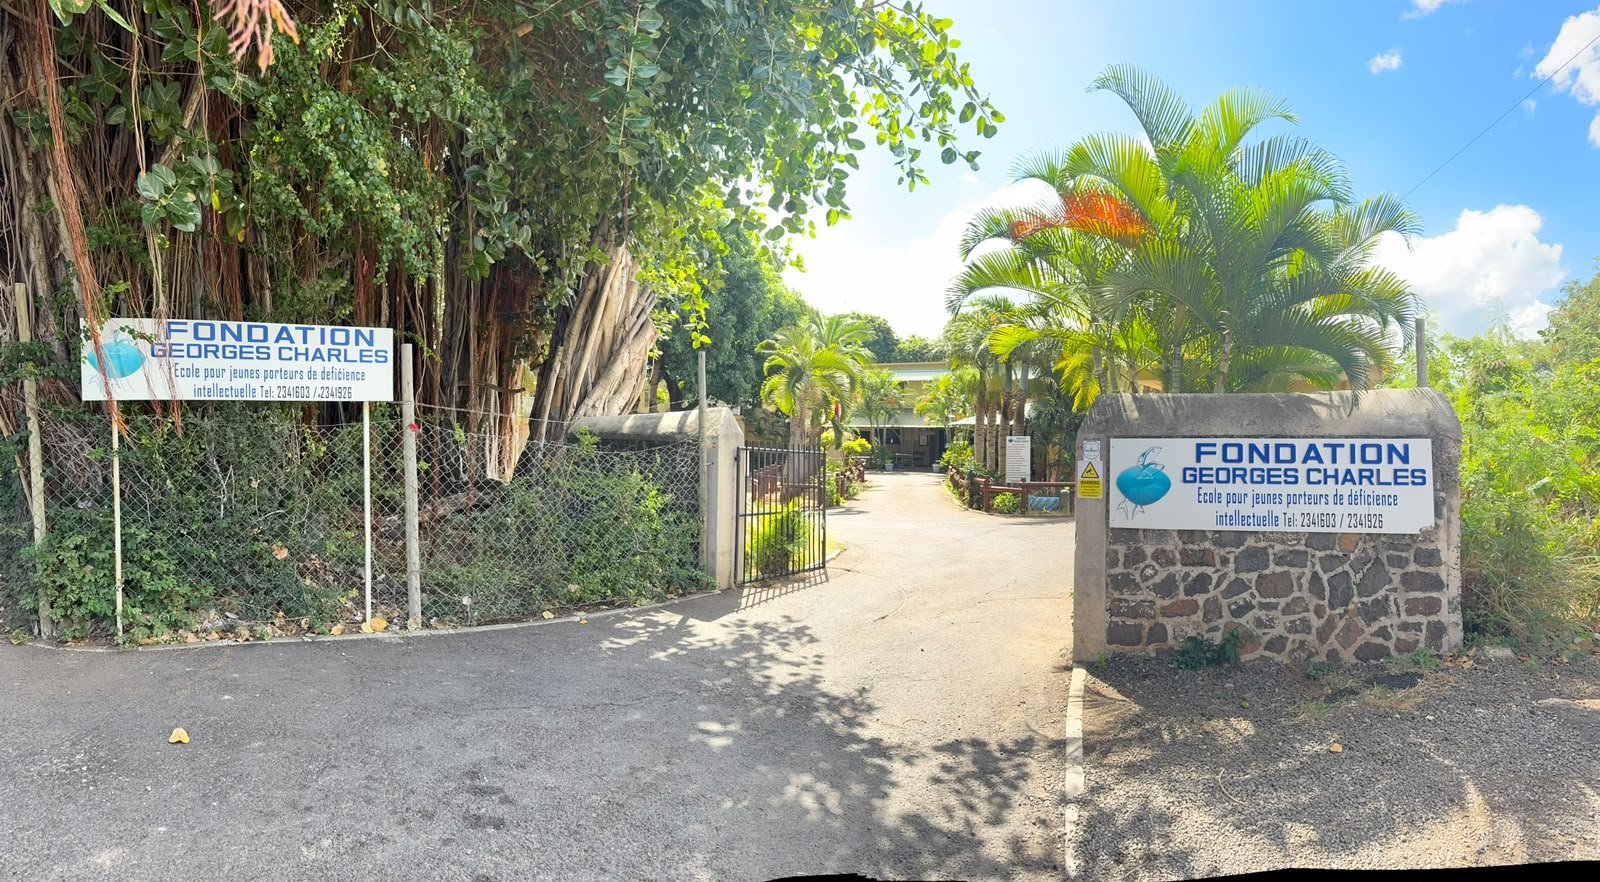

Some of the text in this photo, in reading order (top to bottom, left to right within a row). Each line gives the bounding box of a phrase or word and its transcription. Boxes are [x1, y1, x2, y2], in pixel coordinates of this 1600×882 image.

[166, 321, 374, 346] FONDATION
[150, 343, 388, 364] GEORGES CHARLES
[174, 363, 200, 378] Ecole
[204, 367, 226, 381] pour
[229, 366, 260, 382] jeunes
[264, 368, 304, 382] porteurs
[308, 366, 317, 380] de
[194, 384, 256, 398] intellectuelle
[260, 386, 274, 398] Tel:
[277, 386, 310, 398] 2341603
[1196, 442, 1410, 464] FONDATION
[1182, 467, 1427, 486] GEORGES CHARLES
[1198, 487, 1398, 508] Ecole pour jeunes porteurs de déficience
[1216, 510, 1383, 528] intellectuelle Tel: 2341603 / 2341926
